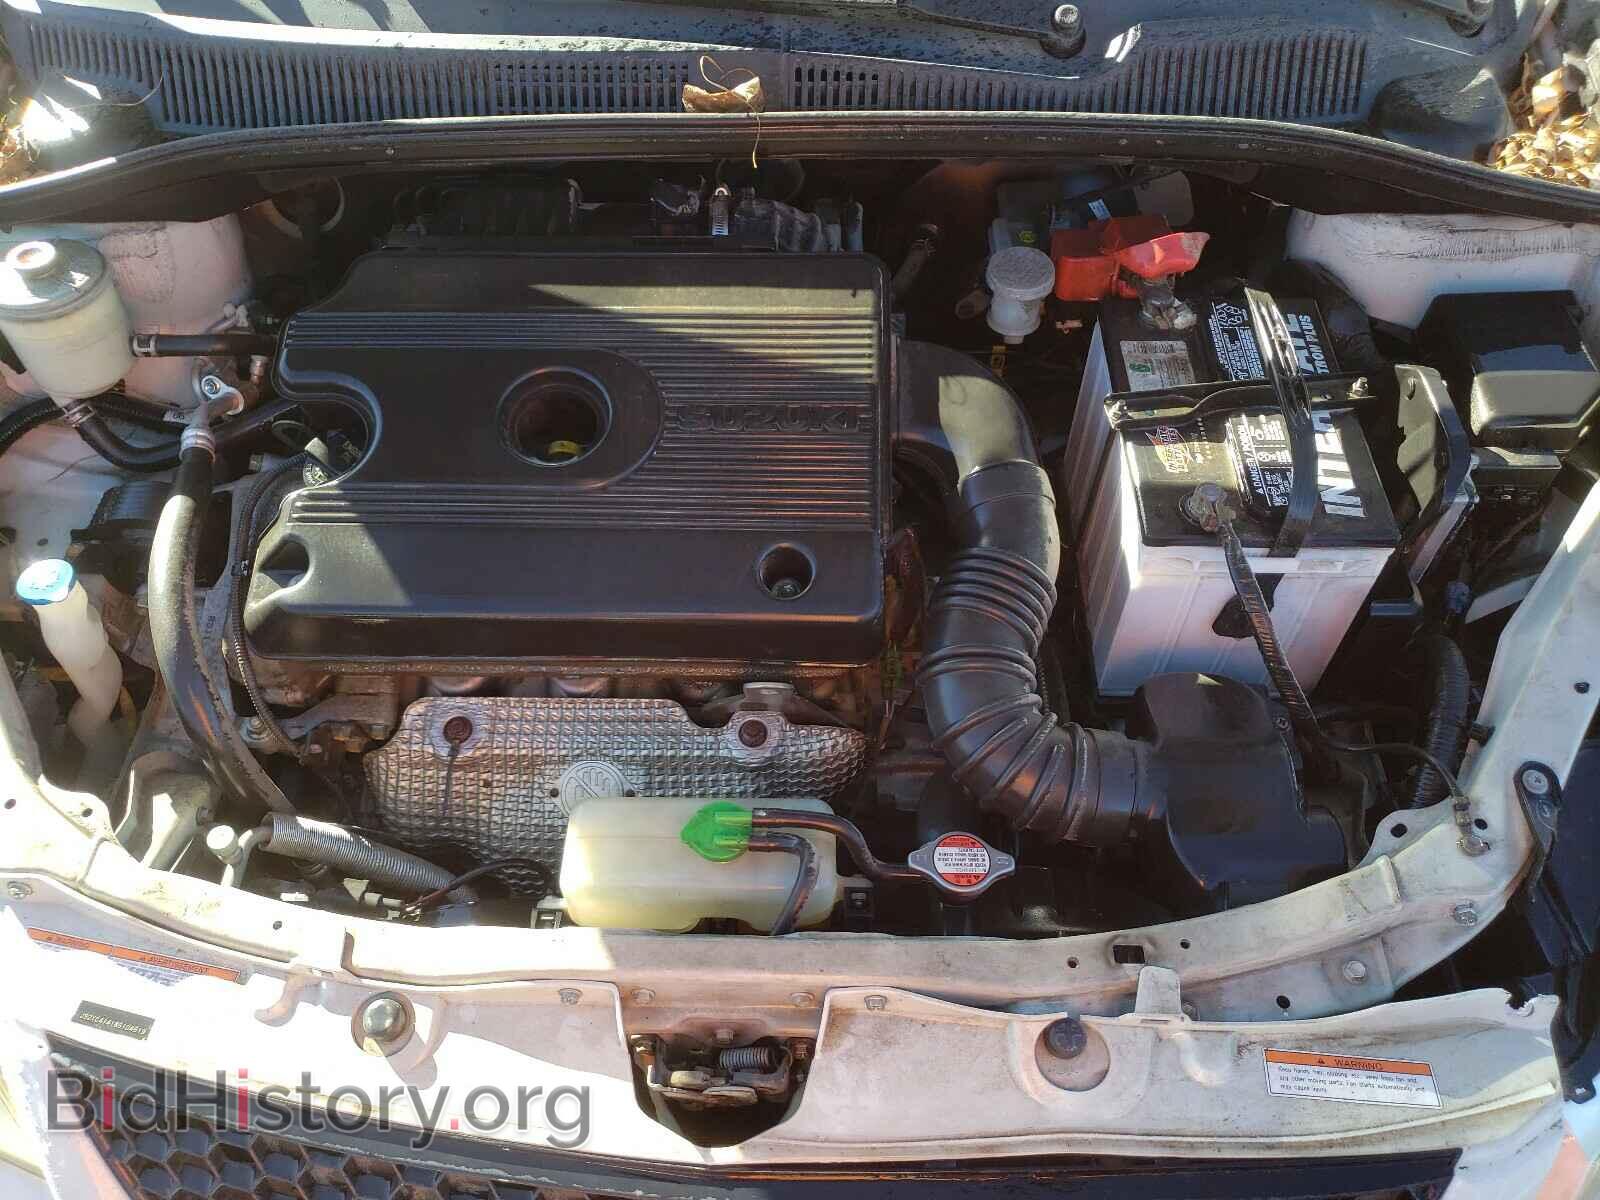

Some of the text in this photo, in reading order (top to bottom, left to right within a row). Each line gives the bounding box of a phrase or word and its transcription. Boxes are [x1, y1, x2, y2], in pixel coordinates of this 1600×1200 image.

[679, 403, 860, 432] SUZUKI
[1245, 457, 1263, 488] DANGER
[1334, 1057, 1384, 1071] WARNING
